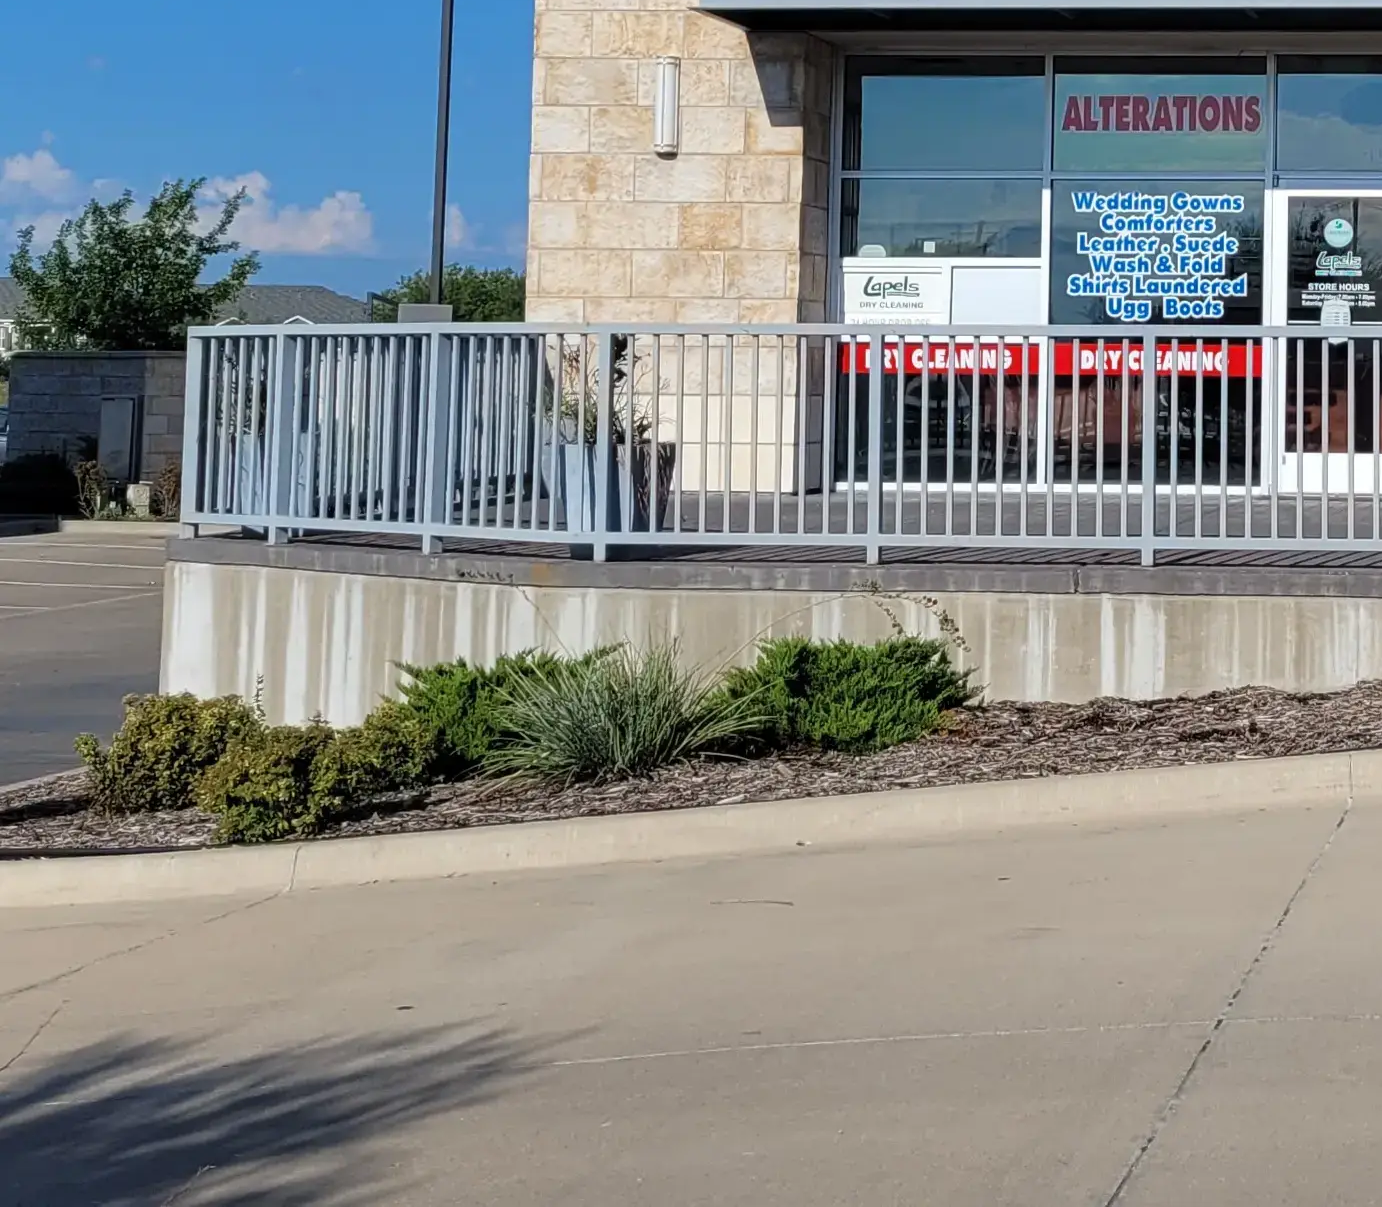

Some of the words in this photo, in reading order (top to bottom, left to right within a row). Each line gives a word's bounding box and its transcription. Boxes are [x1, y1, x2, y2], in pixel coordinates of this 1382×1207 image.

[1062, 95, 1262, 132] ALTERATIONS
[1072, 192, 1167, 214] Wedding
[1171, 192, 1244, 212] Gowns
[1100, 212, 1216, 233] Comforters
[1077, 233, 1158, 254] Leather
[1173, 233, 1238, 254] Suede
[1090, 254, 1151, 275] Wash
[1154, 255, 1176, 275] &
[1178, 254, 1226, 275] Fold
[863, 275, 921, 300] Lapels
[1067, 274, 1130, 296] Shirts
[1133, 274, 1247, 296] Laundered
[1308, 282, 1337, 291] STORE
[1339, 283, 1370, 291] HOURS
[859, 301, 878, 309] DRY
[879, 301, 924, 309] CLEANING
[1106, 296, 1151, 321] Ugg
[1163, 296, 1224, 318] Boots
